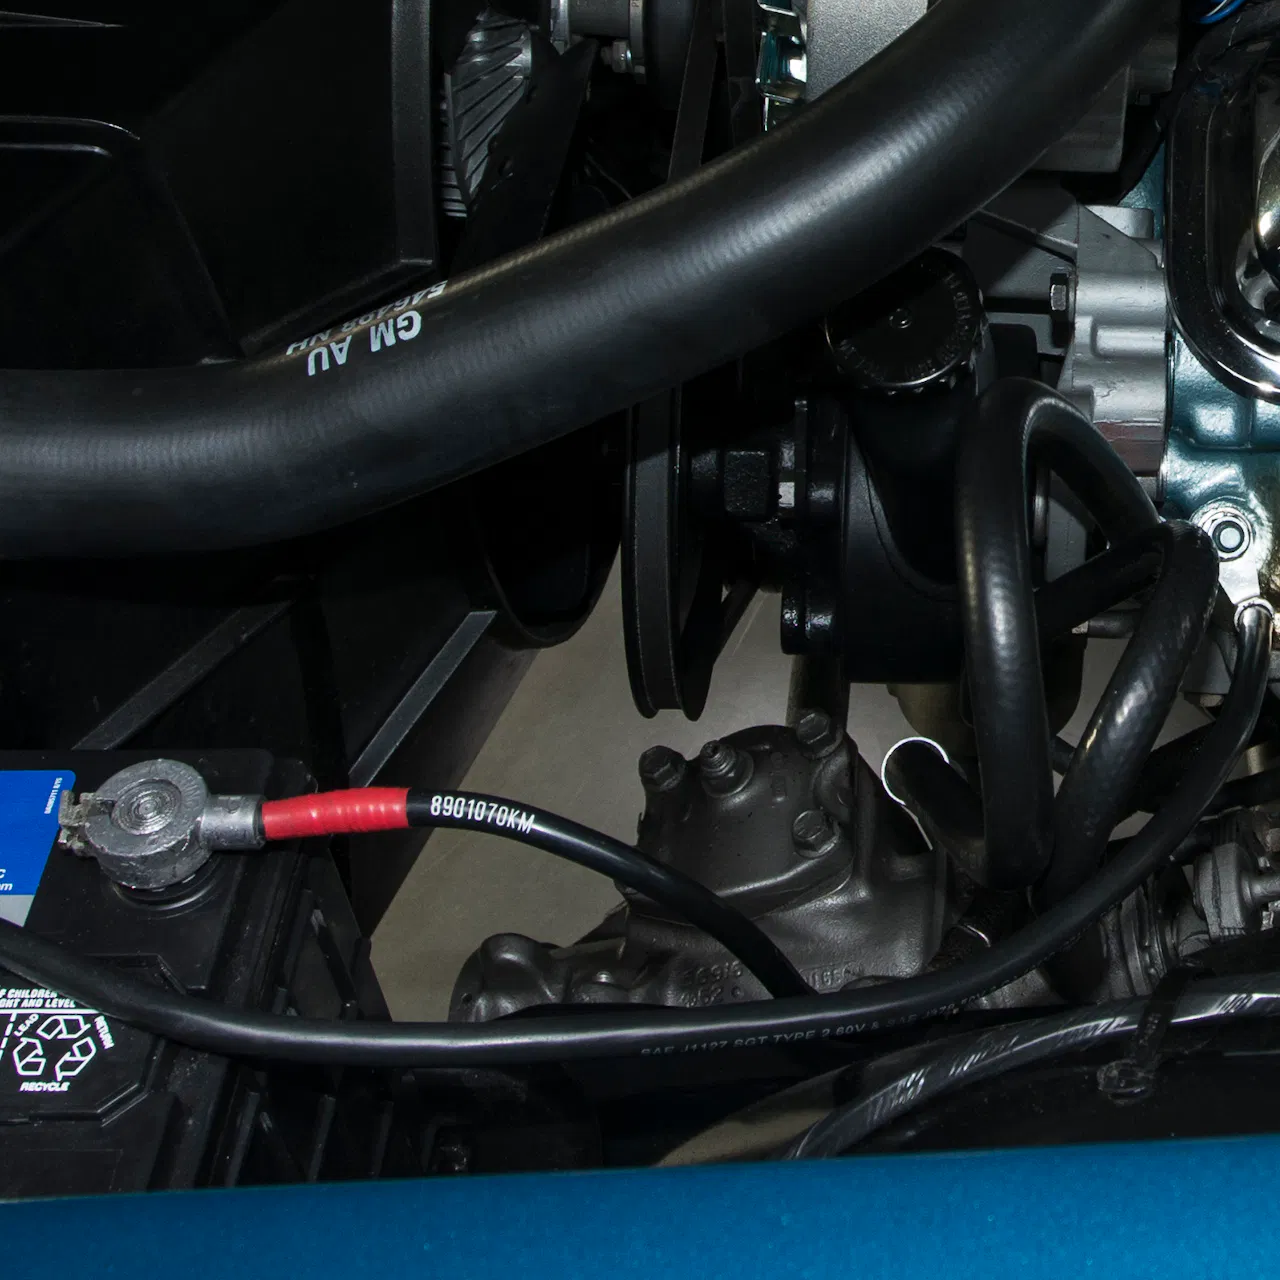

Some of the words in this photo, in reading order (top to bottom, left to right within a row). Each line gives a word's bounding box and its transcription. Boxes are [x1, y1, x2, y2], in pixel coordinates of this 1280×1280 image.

[370, 310, 422, 353] GM
[307, 335, 353, 377] AU
[430, 795, 536, 835] 8901070KM
[20, 998, 44, 1009] AND
[44, 998, 77, 1009] LEVEL
[14, 1013, 40, 1037] LEAD
[94, 1015, 115, 1050] RETURN
[772, 1030, 816, 1044] TYPE
[20, 1082, 71, 1092] RECYCLE
